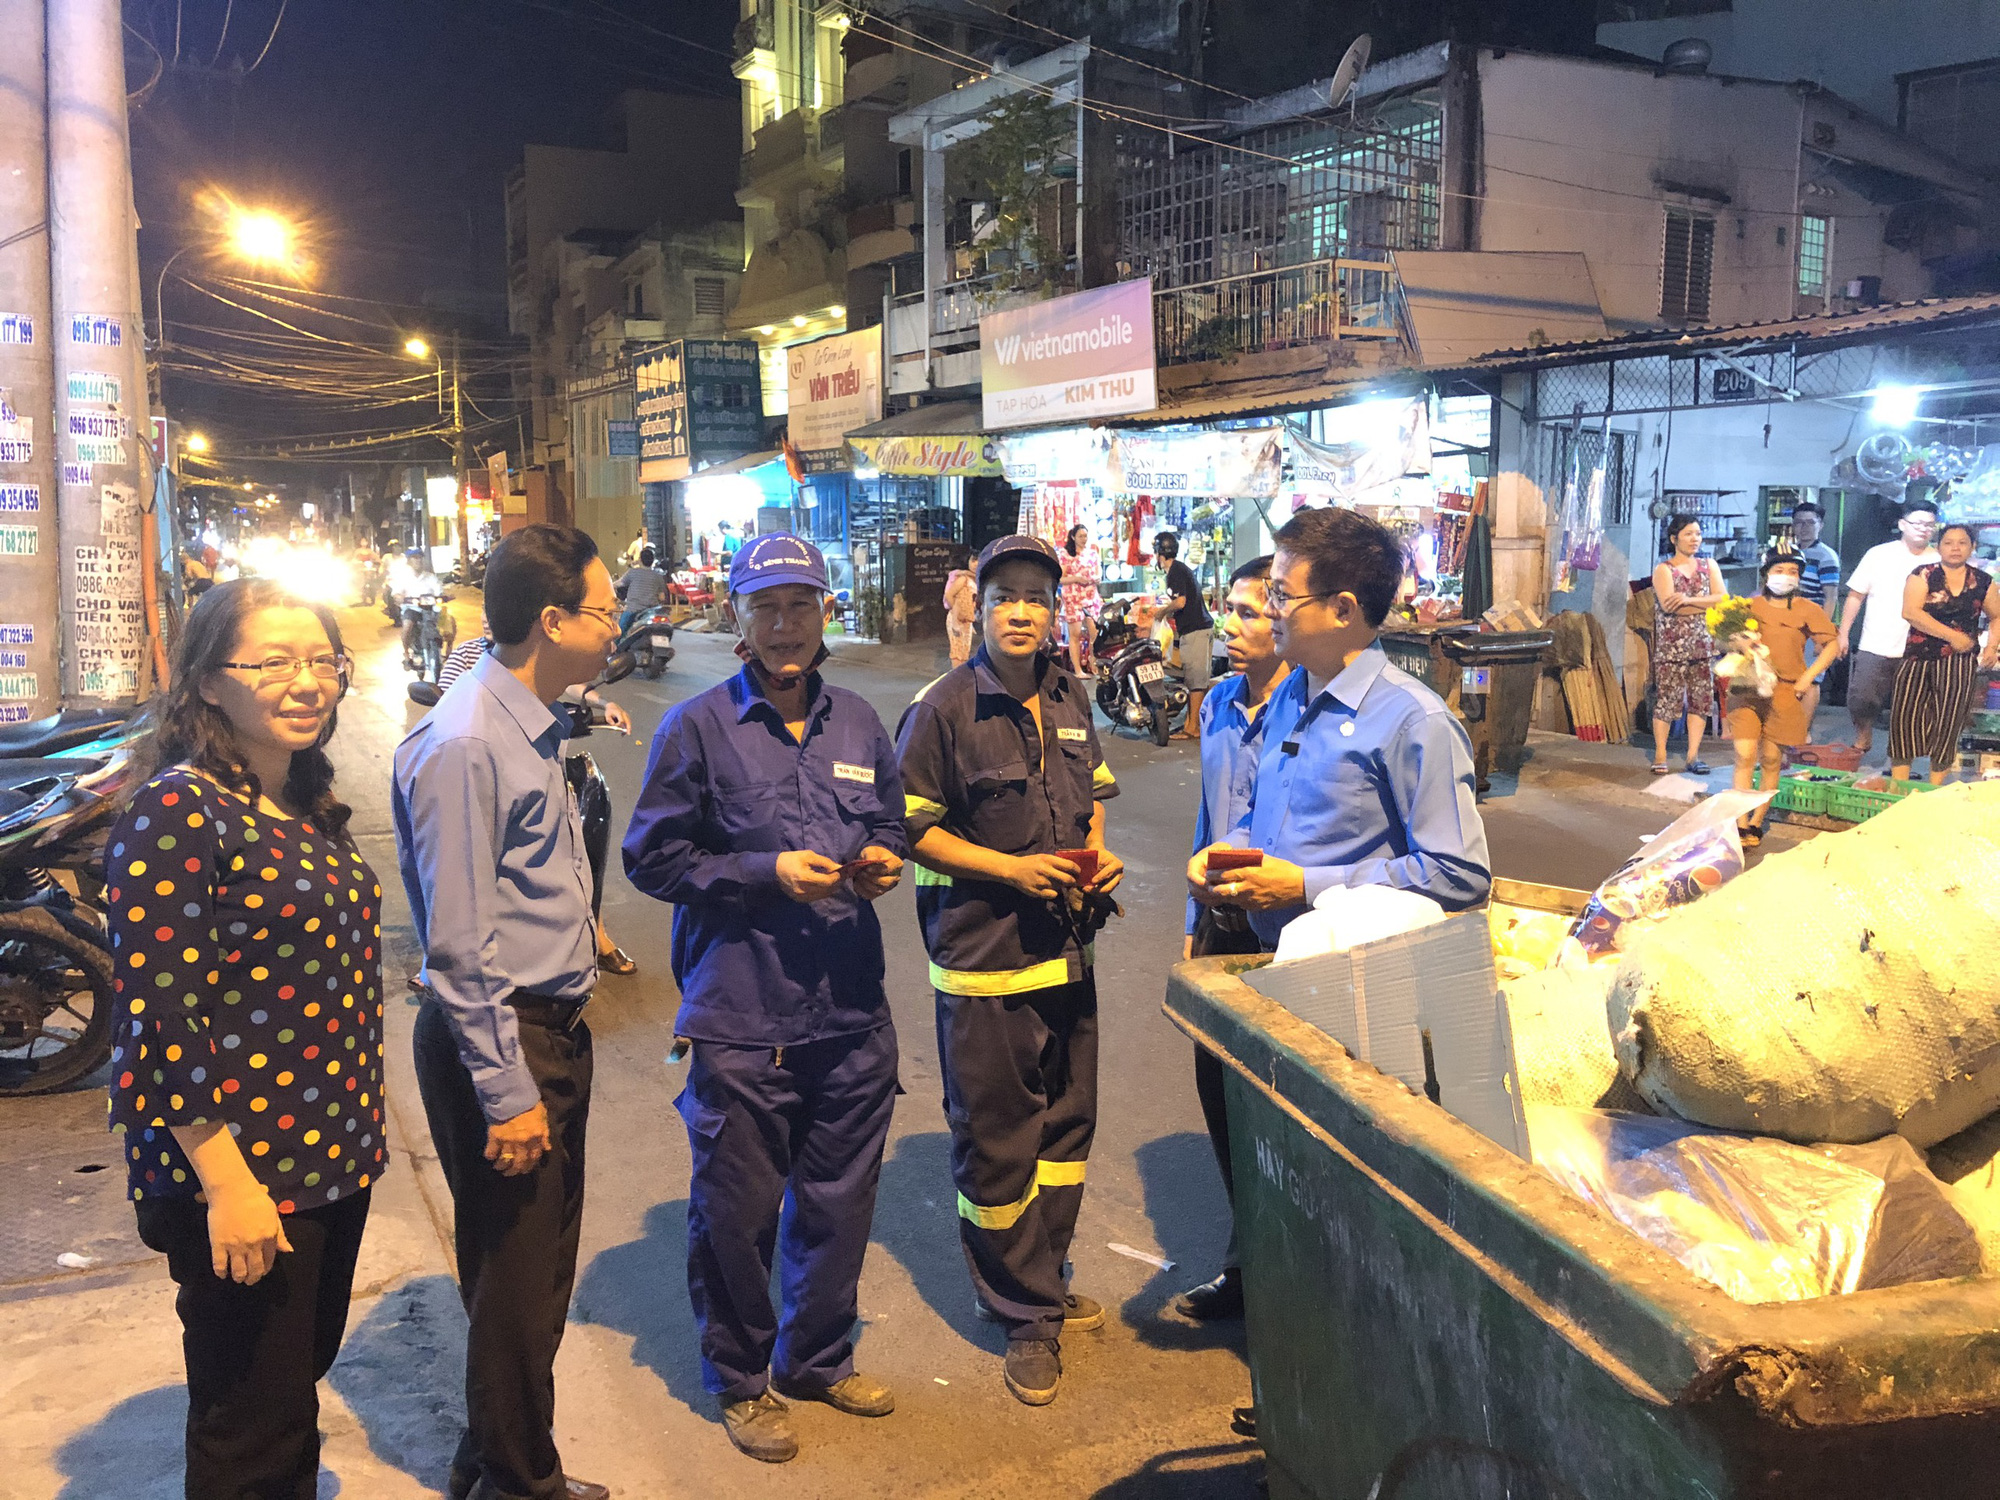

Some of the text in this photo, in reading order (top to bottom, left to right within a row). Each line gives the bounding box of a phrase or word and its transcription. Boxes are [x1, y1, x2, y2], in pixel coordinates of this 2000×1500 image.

[1021, 315, 1133, 362] vietnamobile
[1718, 371, 1750, 392] 209
[996, 377, 1135, 417] TẠP HÓA KIM THU
[70, 415, 86, 435] 0966
[88, 417, 103, 436] 933
[104, 418, 118, 438] 775
[77, 444, 96, 461] 0966
[874, 438, 910, 472] Coffee
[913, 440, 978, 474] Style
[1125, 471, 1188, 490] COOL FRESH
[8, 489, 23, 510] 354
[25, 489, 39, 511] 956
[76, 598, 141, 611] CHO VAY
[8, 628, 20, 643] 322
[21, 628, 33, 644] 566
[0, 653, 26, 668] 004 168
[1255, 1136, 1284, 1191] HÃY
